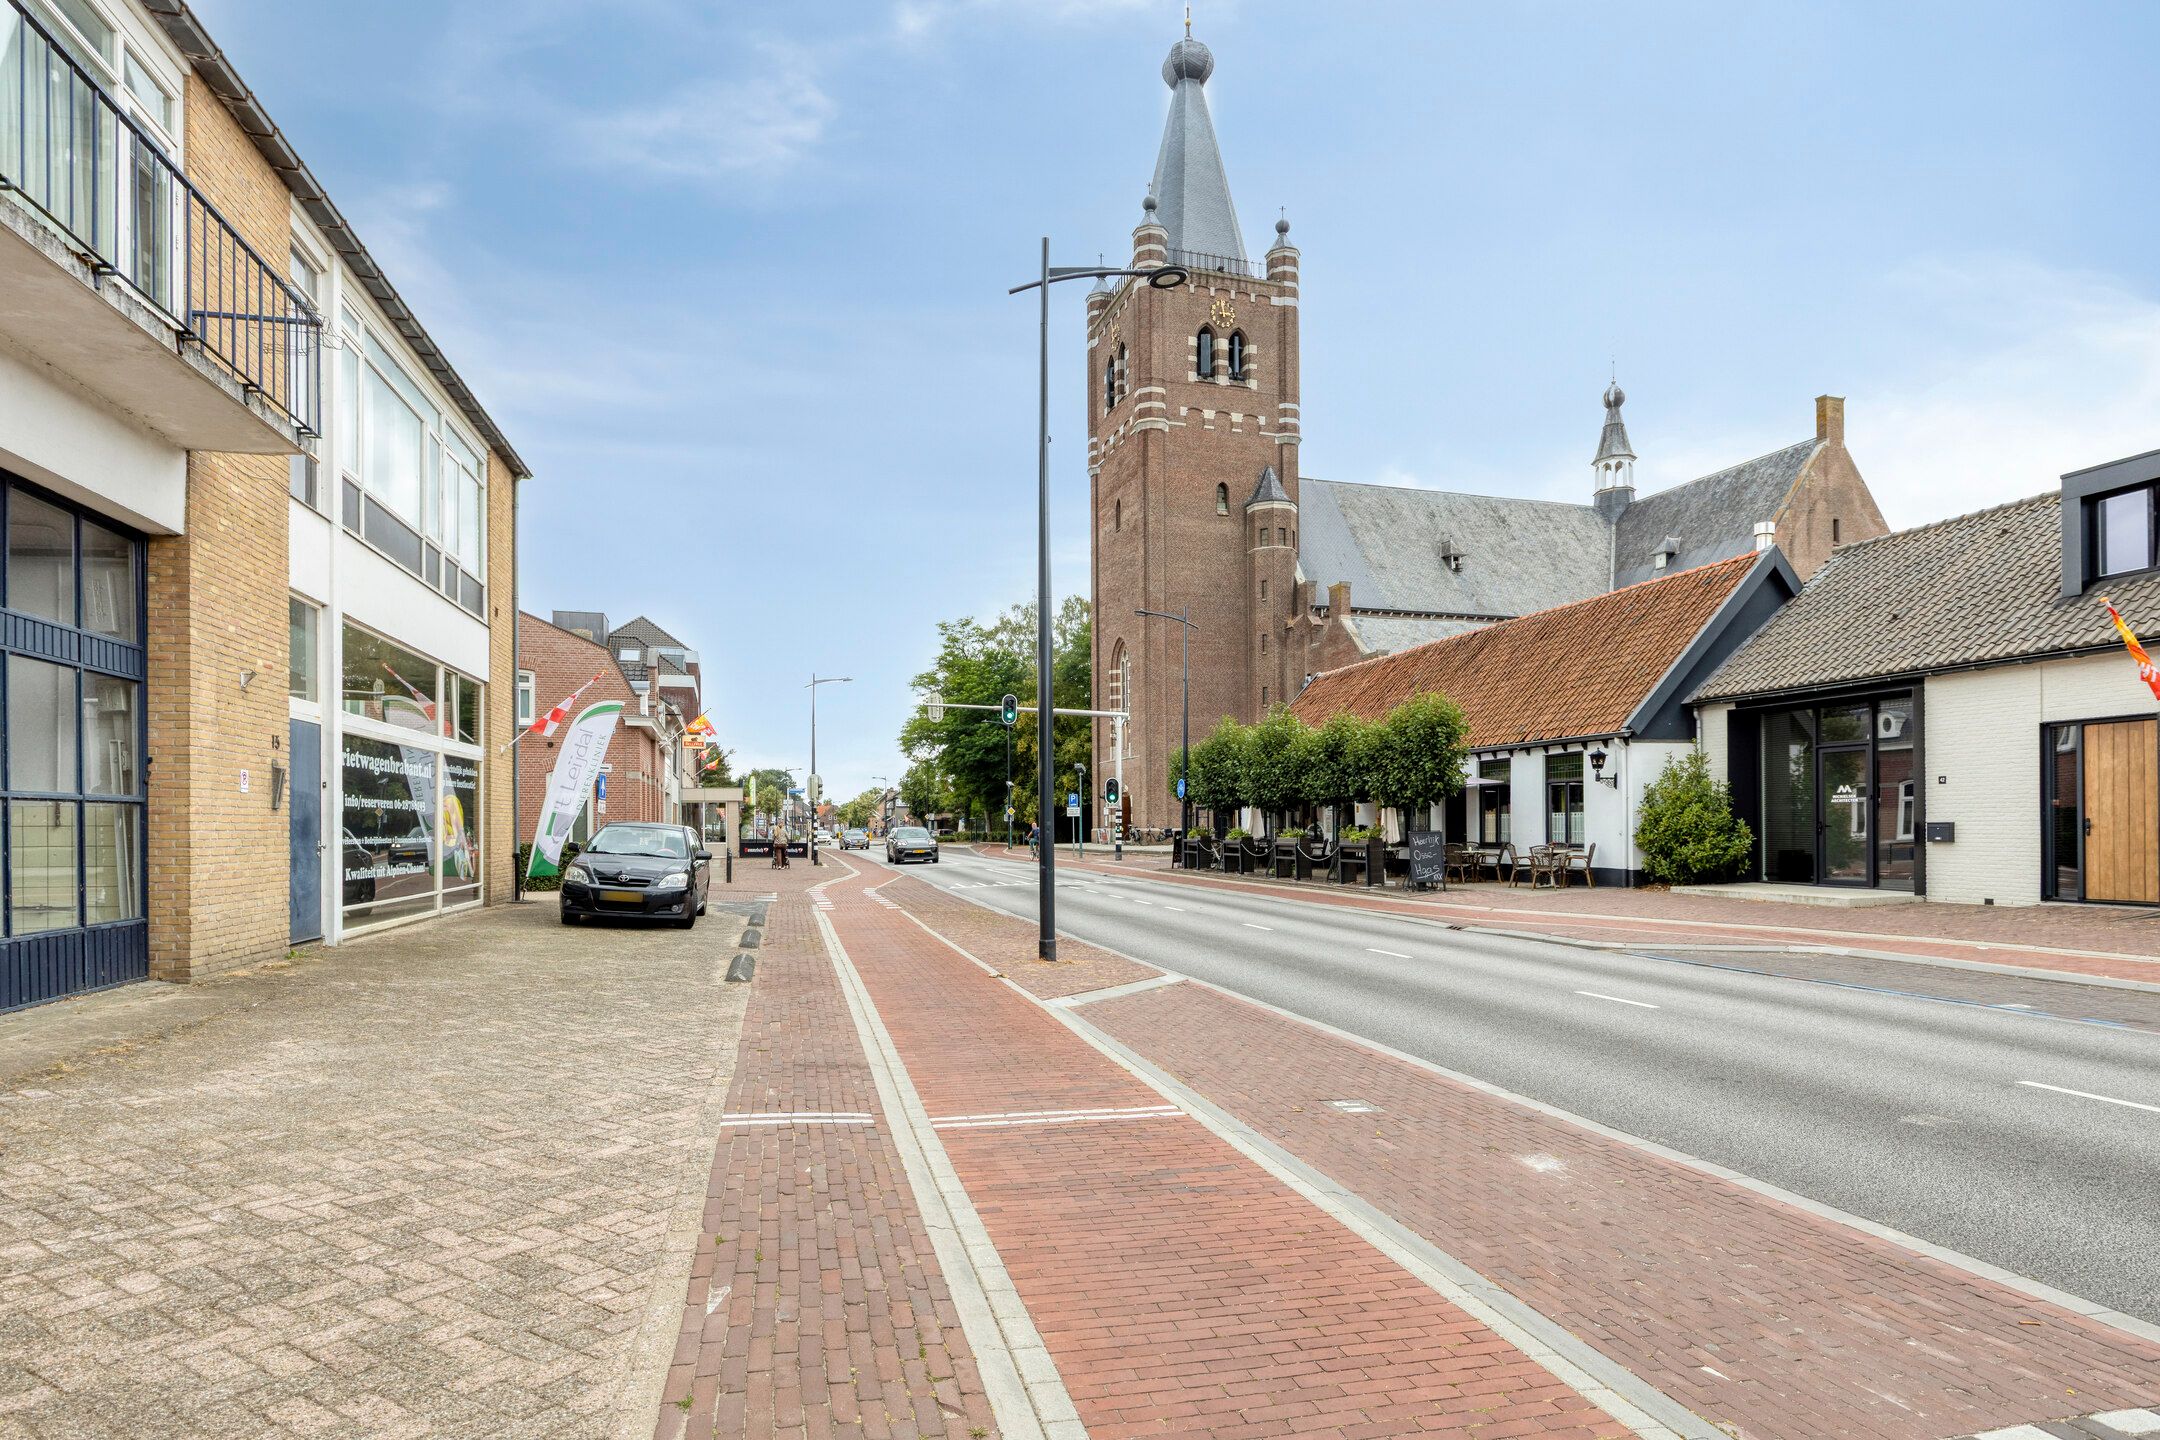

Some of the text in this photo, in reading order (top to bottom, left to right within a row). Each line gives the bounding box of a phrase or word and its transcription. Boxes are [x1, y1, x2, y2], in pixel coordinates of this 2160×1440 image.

[272, 735, 280, 750] 15
[342, 747, 432, 778] rietwagenbrabant.nl
[576, 734, 606, 811] DIERENKLINIEK
[345, 867, 376, 881] Kwaliteit
[376, 866, 385, 877] uit
[1414, 864, 1440, 876] Haas
